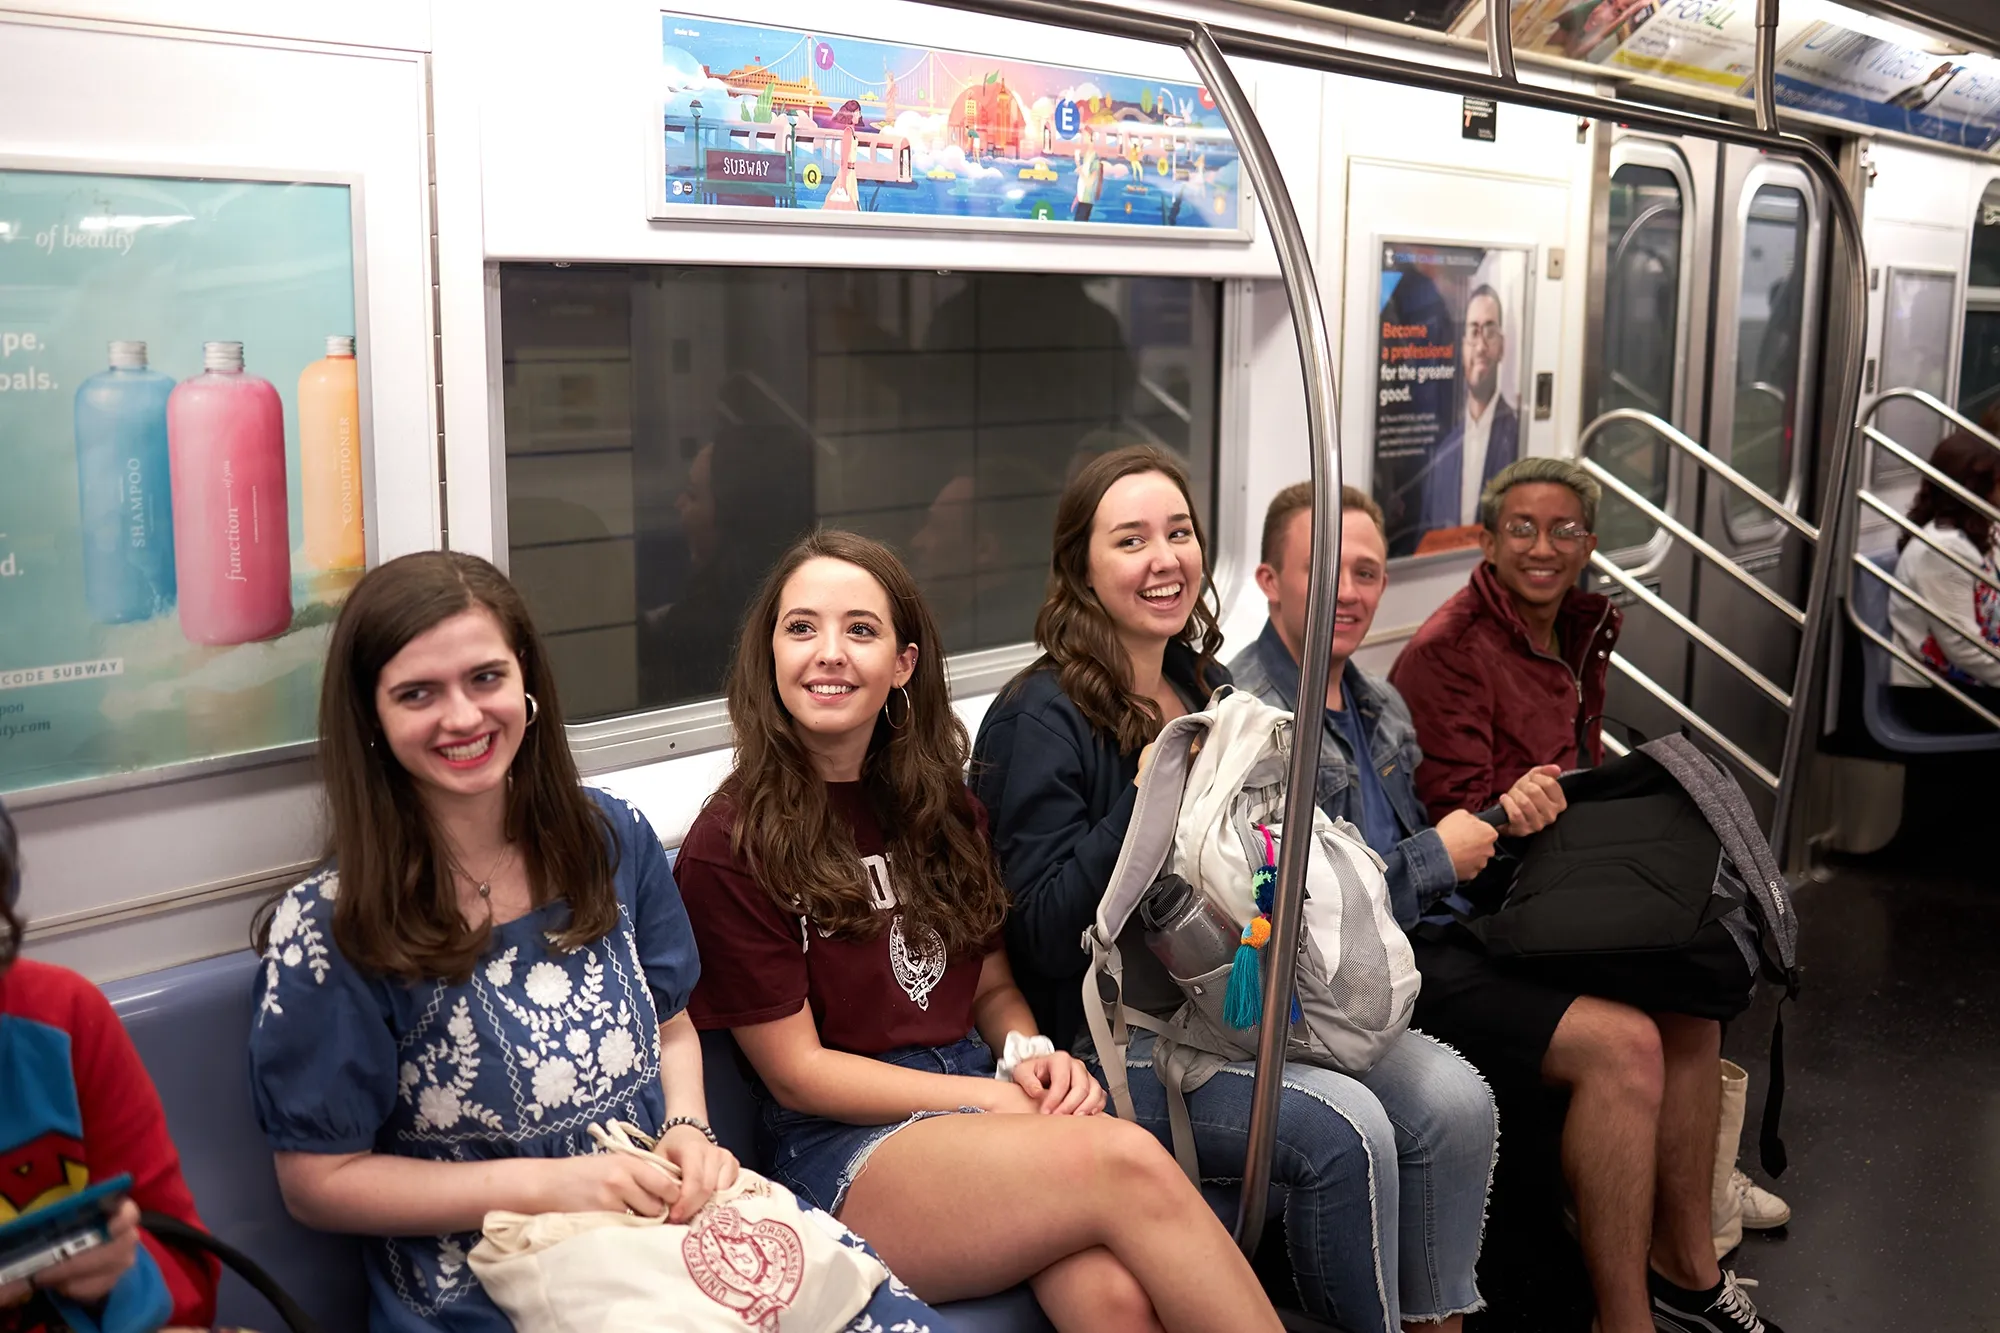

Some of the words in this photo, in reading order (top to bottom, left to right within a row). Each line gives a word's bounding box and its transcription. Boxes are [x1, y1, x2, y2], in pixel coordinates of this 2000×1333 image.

[820, 48, 829, 64] 7
[1061, 107, 1074, 131] E
[722, 156, 770, 177] SUBWAY
[807, 169, 818, 185] Q
[35, 224, 59, 255] of
[63, 224, 135, 256] beauty
[1382, 322, 1428, 339] Become
[1380, 363, 1397, 381] for
[1398, 364, 1416, 381] the
[1417, 364, 1456, 384] greater
[340, 416, 352, 524] CONDITIONER
[127, 458, 146, 548] SHAMPOO
[225, 507, 247, 582] function
[2, 670, 45, 686] CODE
[52, 661, 118, 679] SUBWAY
[1769, 881, 1785, 915] adidas
